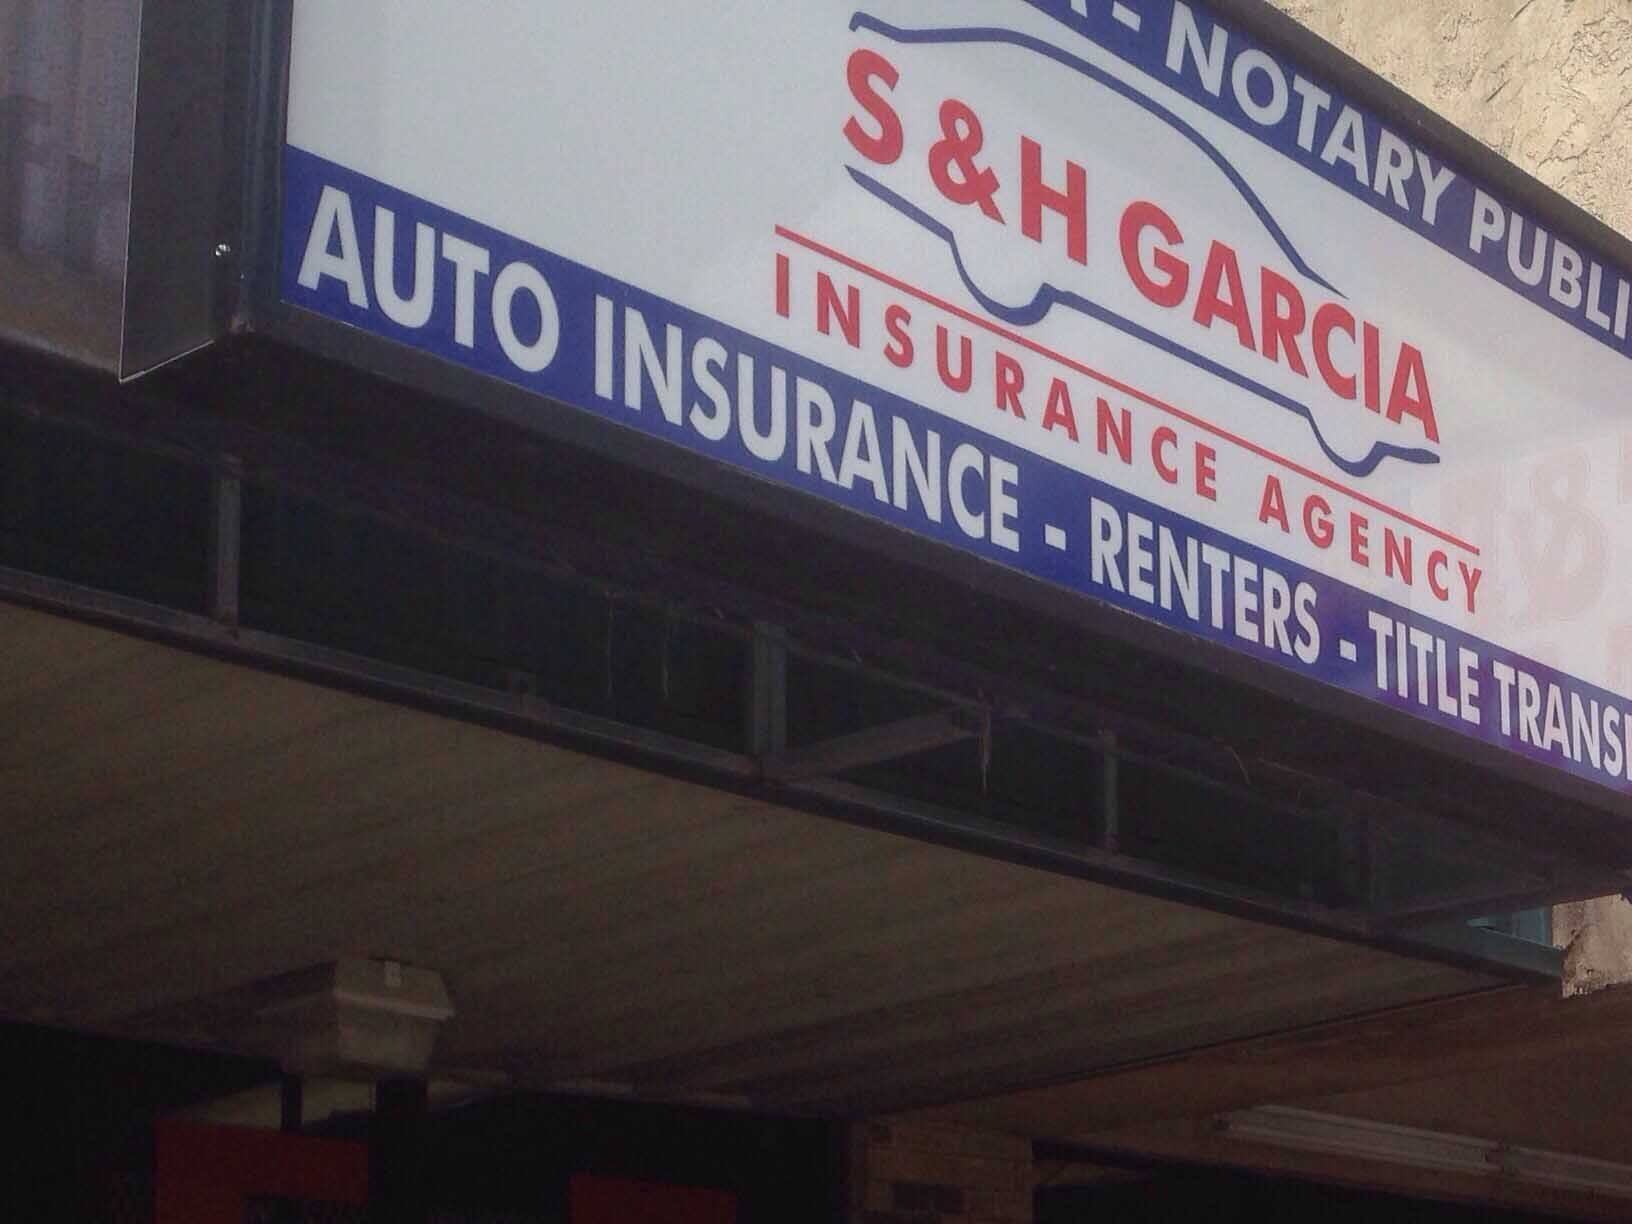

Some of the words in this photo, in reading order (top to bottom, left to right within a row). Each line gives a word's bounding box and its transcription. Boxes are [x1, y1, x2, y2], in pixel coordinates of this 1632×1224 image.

[1166, 1, 1456, 226] NOTARY
[298, 185, 558, 373] AUTO
[595, 294, 1018, 553] INSURANCE
[1091, 498, 1320, 665] RENTERS
[1368, 612, 1480, 726] TITLE
[775, 253, 1217, 501] INSURANCE
[1259, 475, 1482, 615] AGENCY
[1119, 200, 1440, 443] GARCIA
